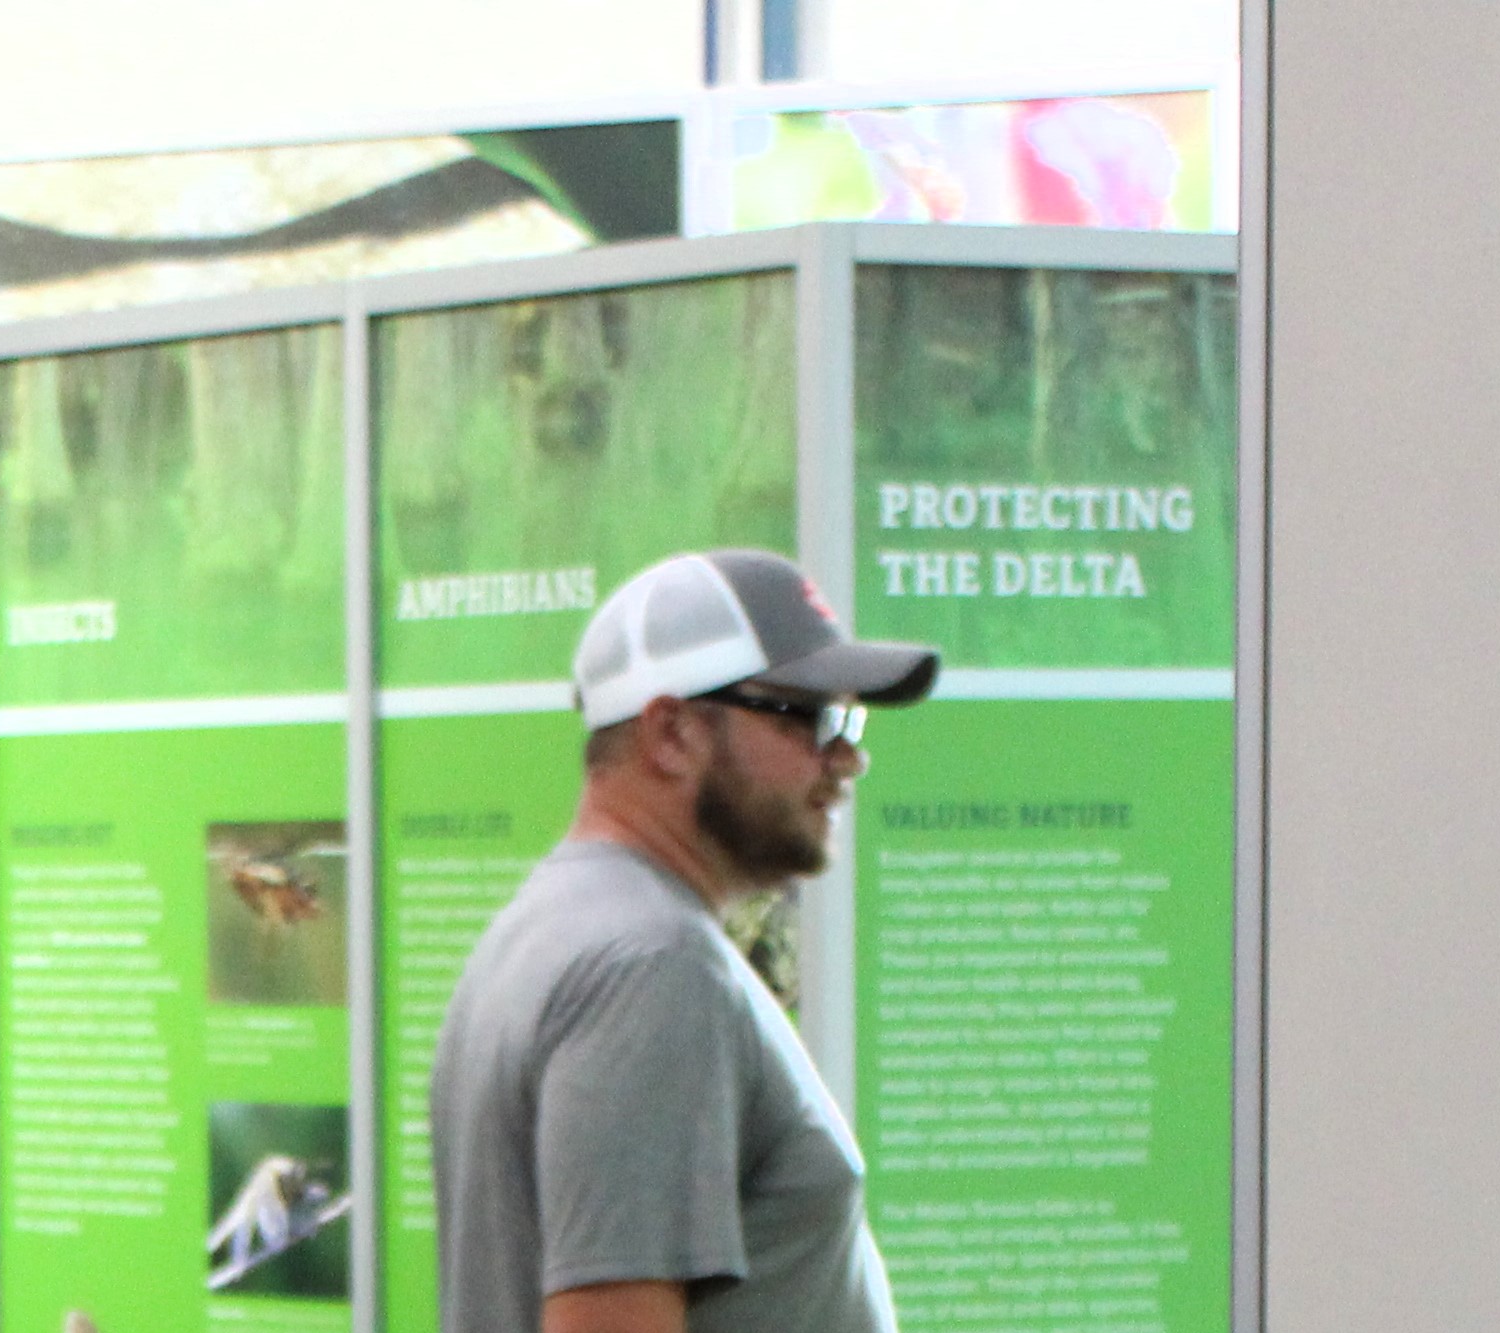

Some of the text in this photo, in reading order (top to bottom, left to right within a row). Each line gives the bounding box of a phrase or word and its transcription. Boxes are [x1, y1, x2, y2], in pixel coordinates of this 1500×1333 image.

[877, 482, 1195, 531] PROTECTING
[398, 568, 596, 621] AMPHIBIANS
[877, 550, 1147, 598] THE DELTA
